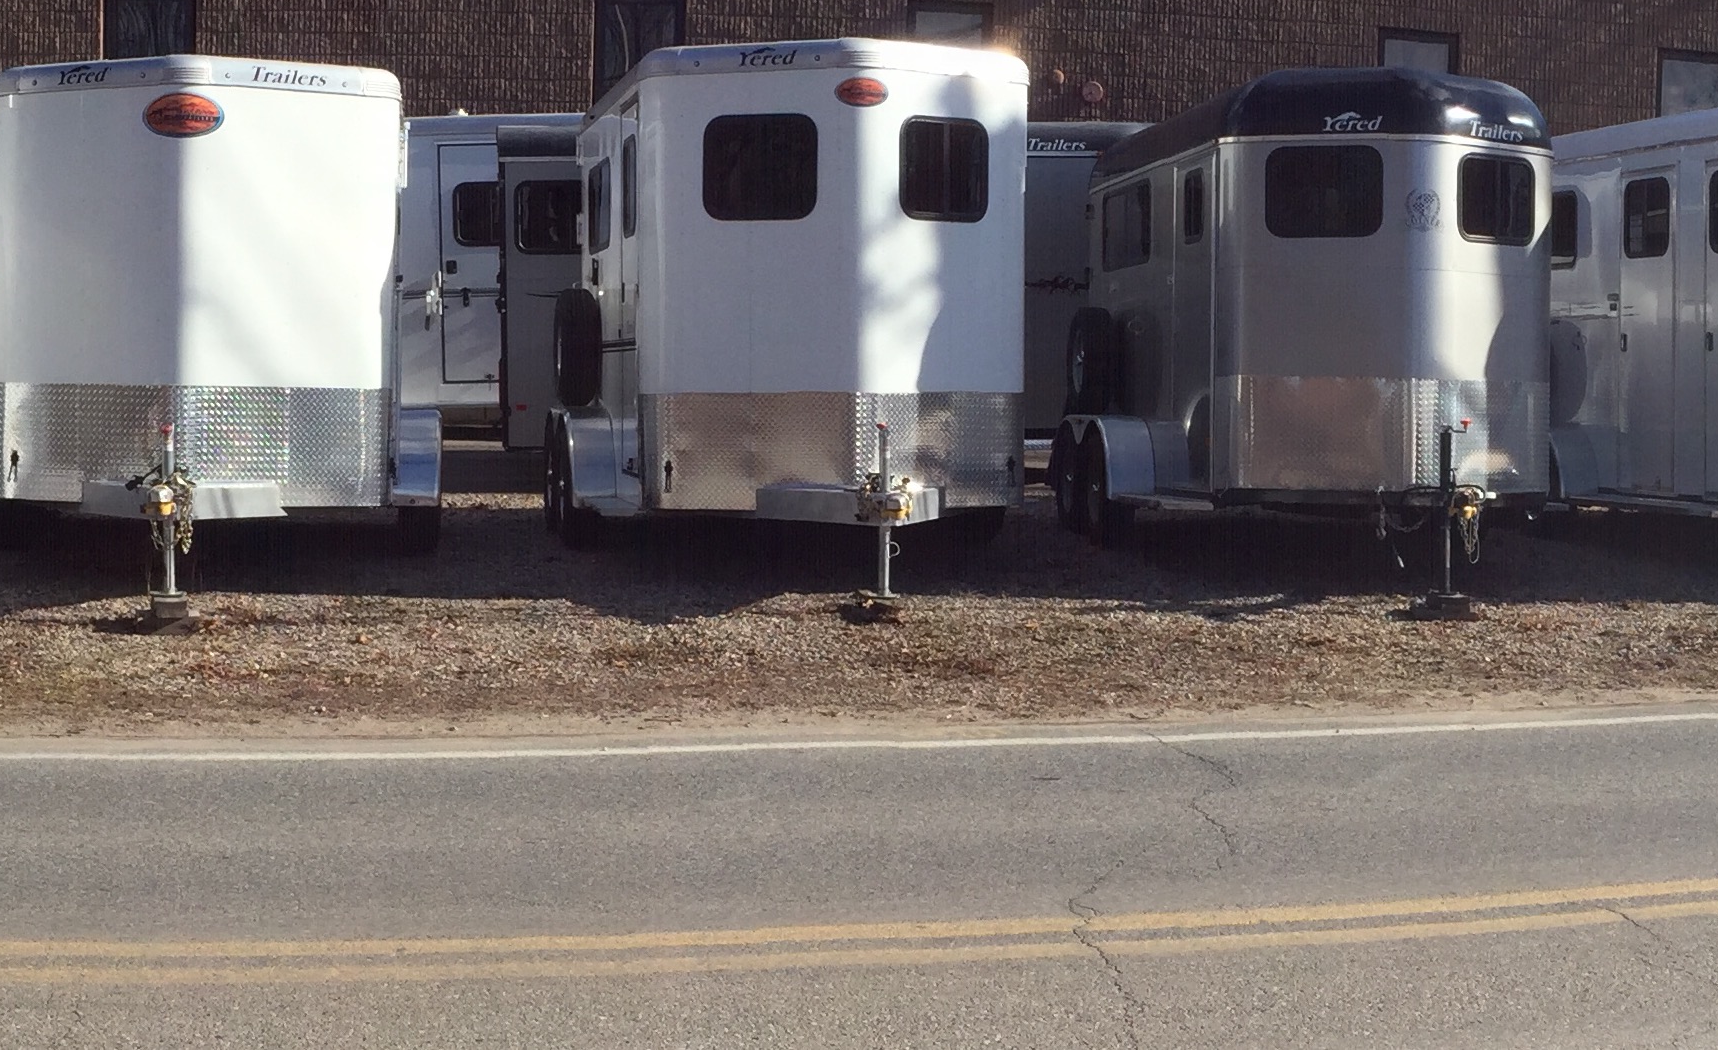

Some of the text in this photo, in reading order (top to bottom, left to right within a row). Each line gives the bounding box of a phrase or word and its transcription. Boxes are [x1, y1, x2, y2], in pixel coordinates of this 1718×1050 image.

[738, 46, 798, 68] Yered
[57, 64, 328, 87] Yered Trailers
[1322, 111, 1524, 143] Yered Trailers
[1027, 137, 1087, 151] Trailers
